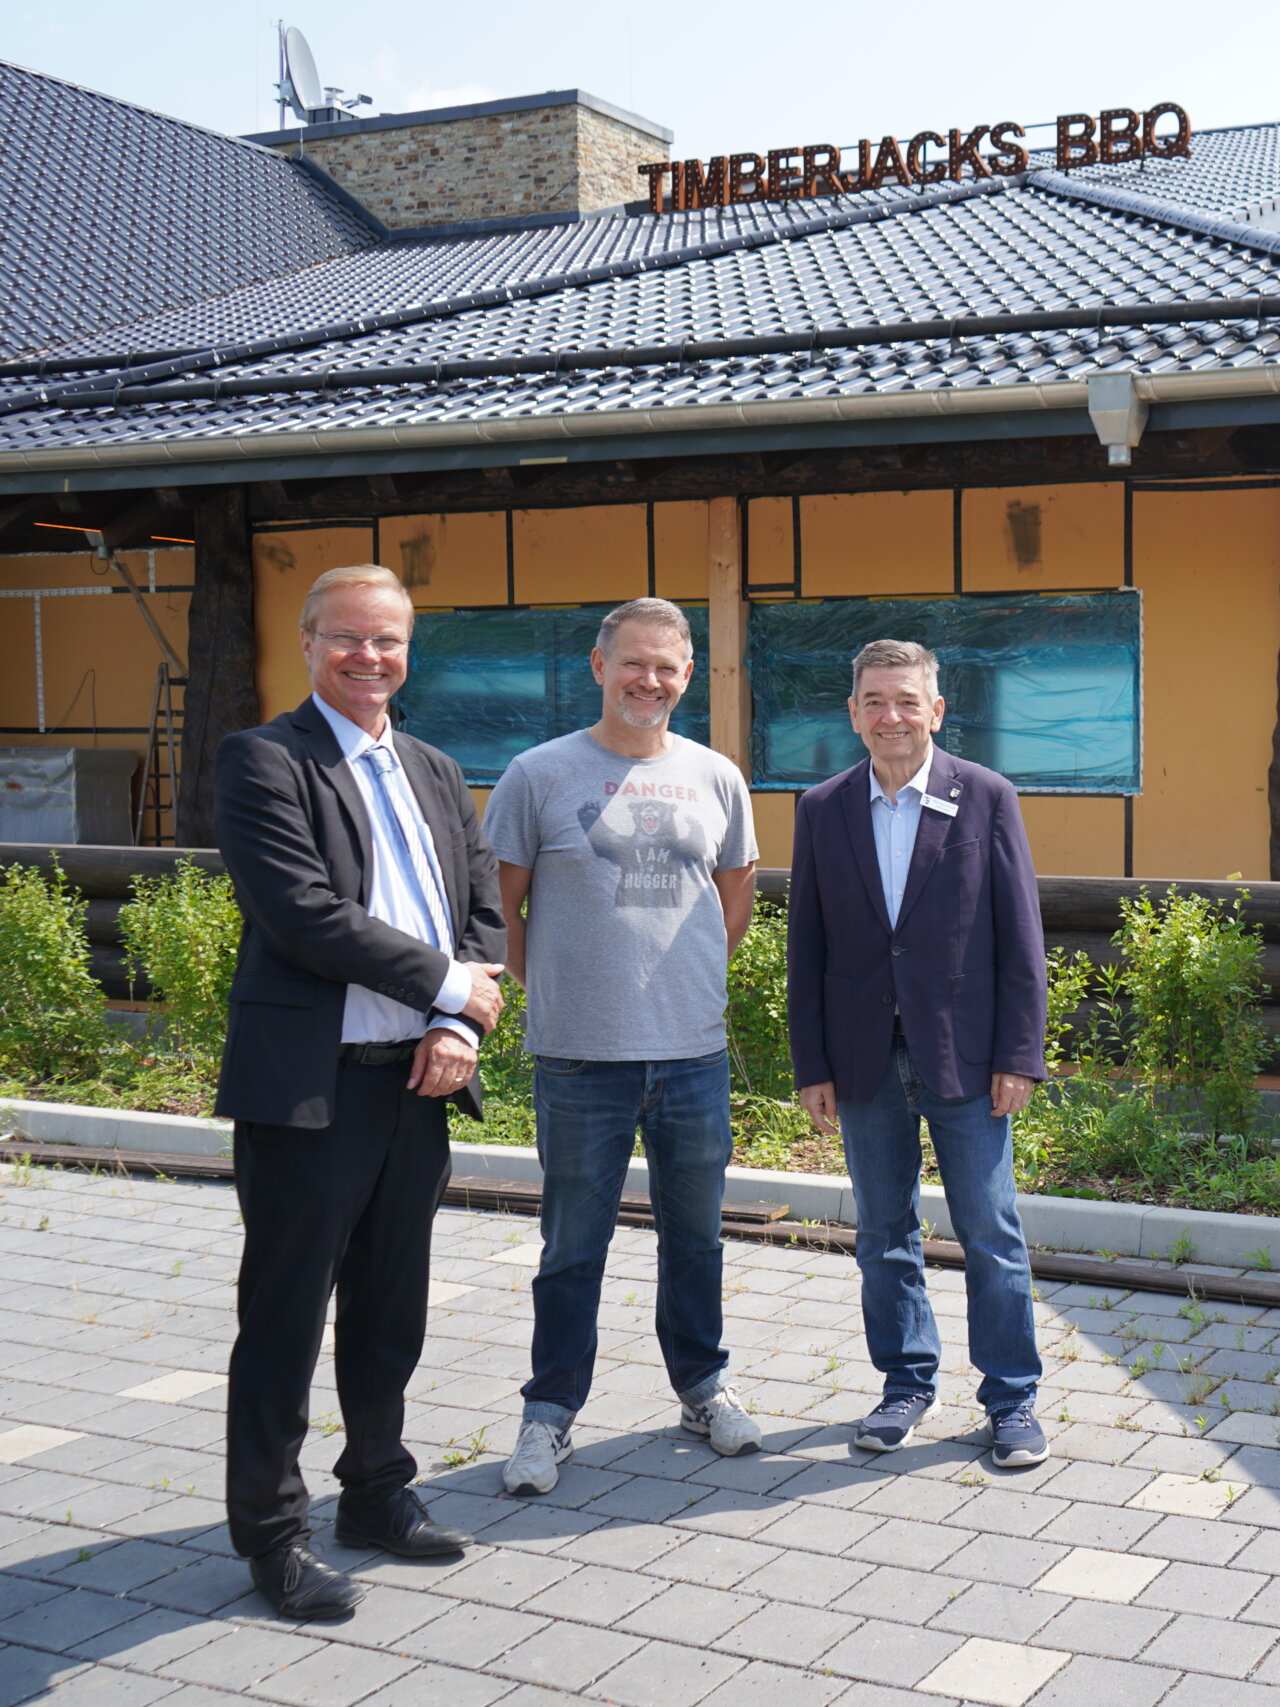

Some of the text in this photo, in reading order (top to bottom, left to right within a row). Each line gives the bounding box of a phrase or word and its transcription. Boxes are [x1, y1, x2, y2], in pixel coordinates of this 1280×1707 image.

[637, 102, 1192, 214] TIMBERJACKS BBQ
[604, 781, 698, 802] DANGER
[635, 847, 671, 864] I AM
[624, 873, 677, 889] HUGGER
